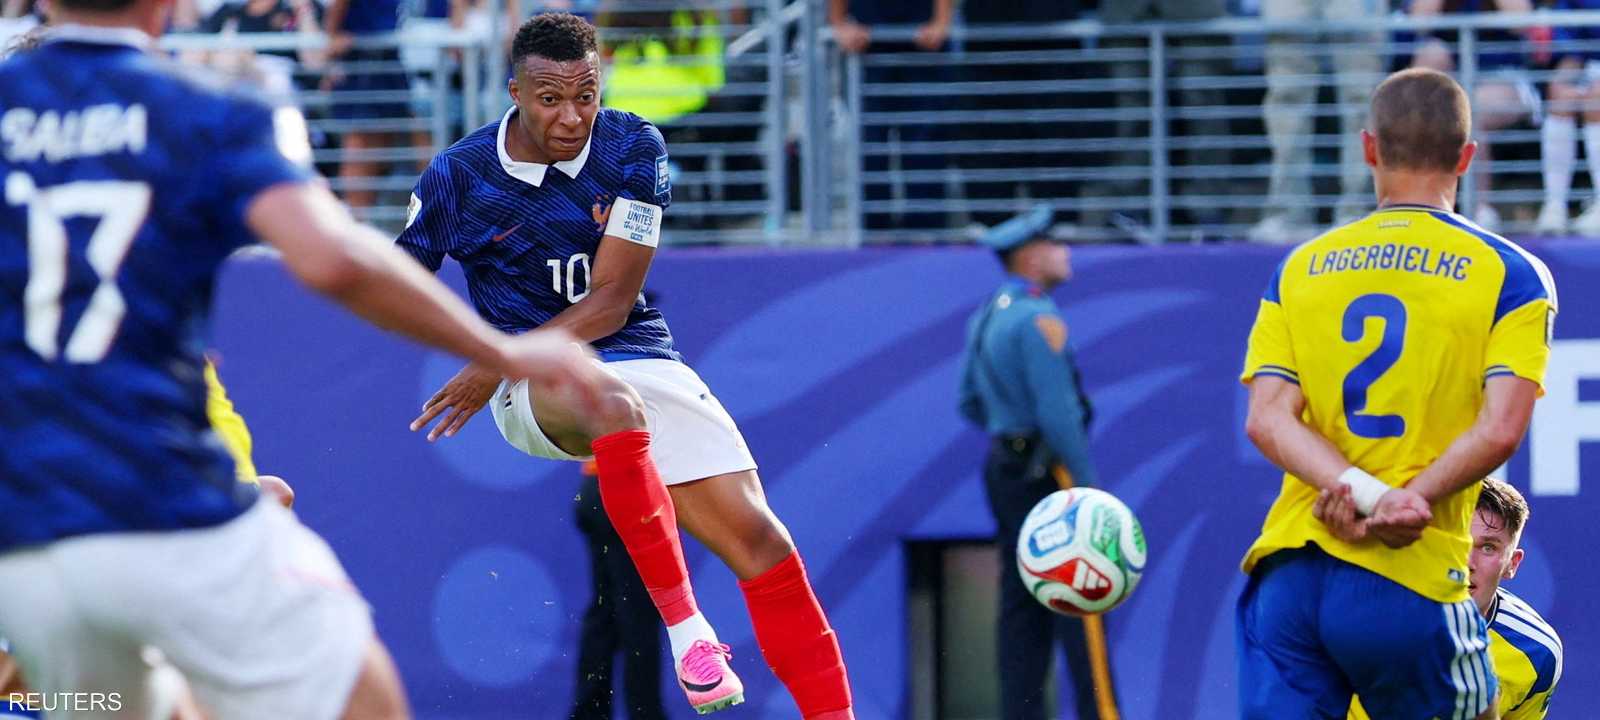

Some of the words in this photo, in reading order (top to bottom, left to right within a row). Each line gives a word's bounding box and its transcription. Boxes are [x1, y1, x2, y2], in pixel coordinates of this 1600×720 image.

[627, 210, 654, 226] UNITES
[5, 171, 152, 362] 17
[546, 253, 591, 304] 10
[1308, 243, 1472, 281] LAGERBIELKE
[1341, 293, 1407, 438] 2
